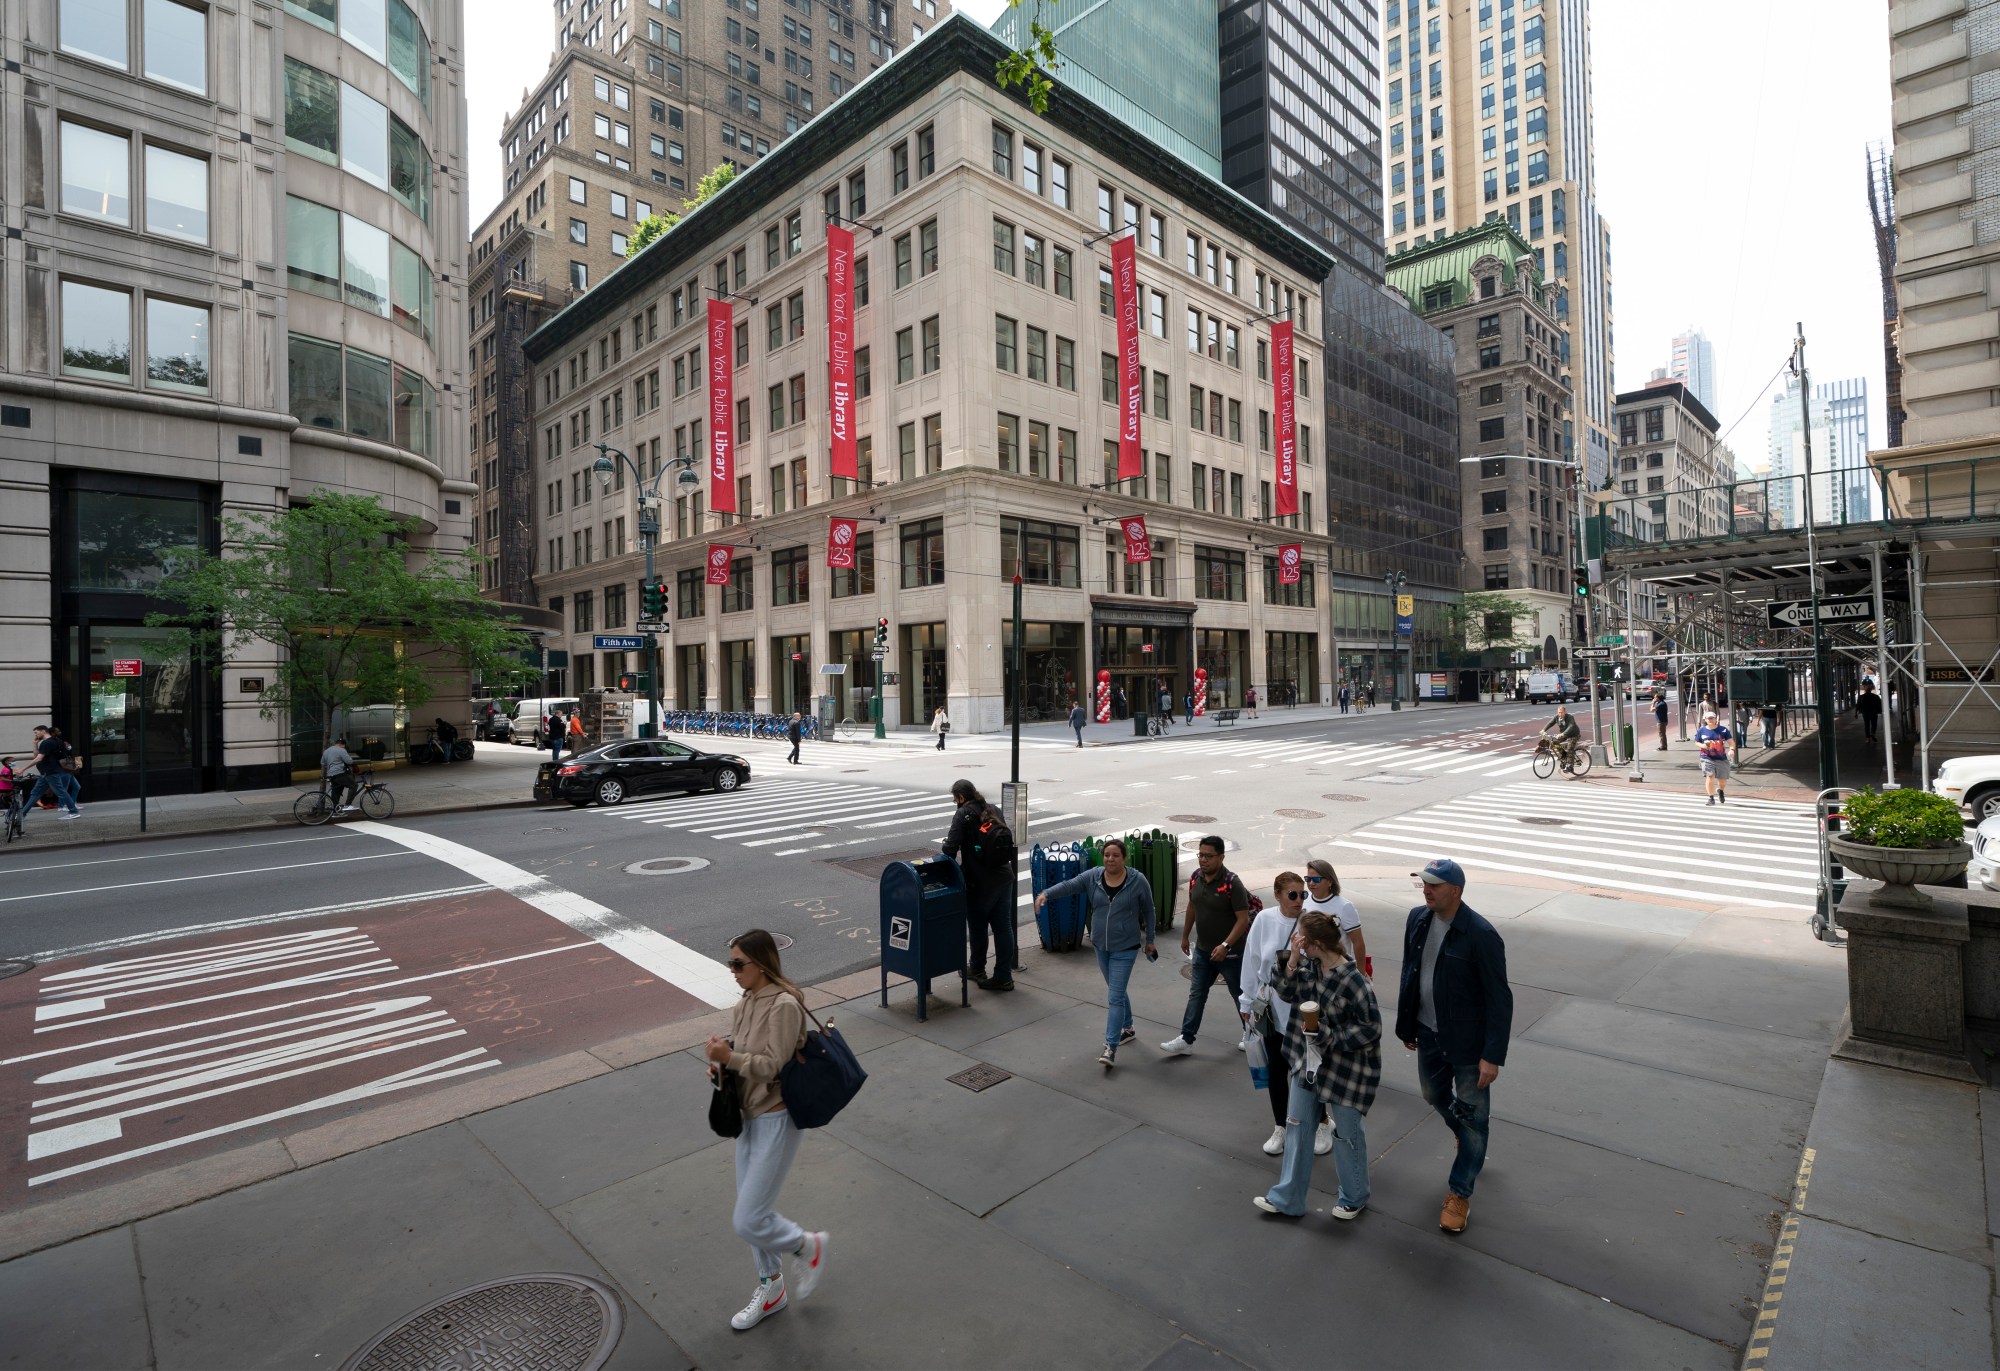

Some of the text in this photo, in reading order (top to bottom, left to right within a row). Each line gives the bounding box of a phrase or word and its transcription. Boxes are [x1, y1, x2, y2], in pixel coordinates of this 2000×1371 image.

[833, 250, 850, 441] New York Public Library
[1120, 257, 1140, 442] New York Public Library
[713, 319, 728, 481] New York Public Library
[1278, 337, 1293, 486] New York Public Library
[830, 547, 851, 566] 125
[1129, 542, 1150, 559] 125
[709, 567, 727, 583] 125
[1281, 566, 1300, 581] 125
[1787, 604, 1863, 620] ONE WAY
[1930, 670, 1965, 679] HSBC
[1421, 739, 1490, 749] BUS
